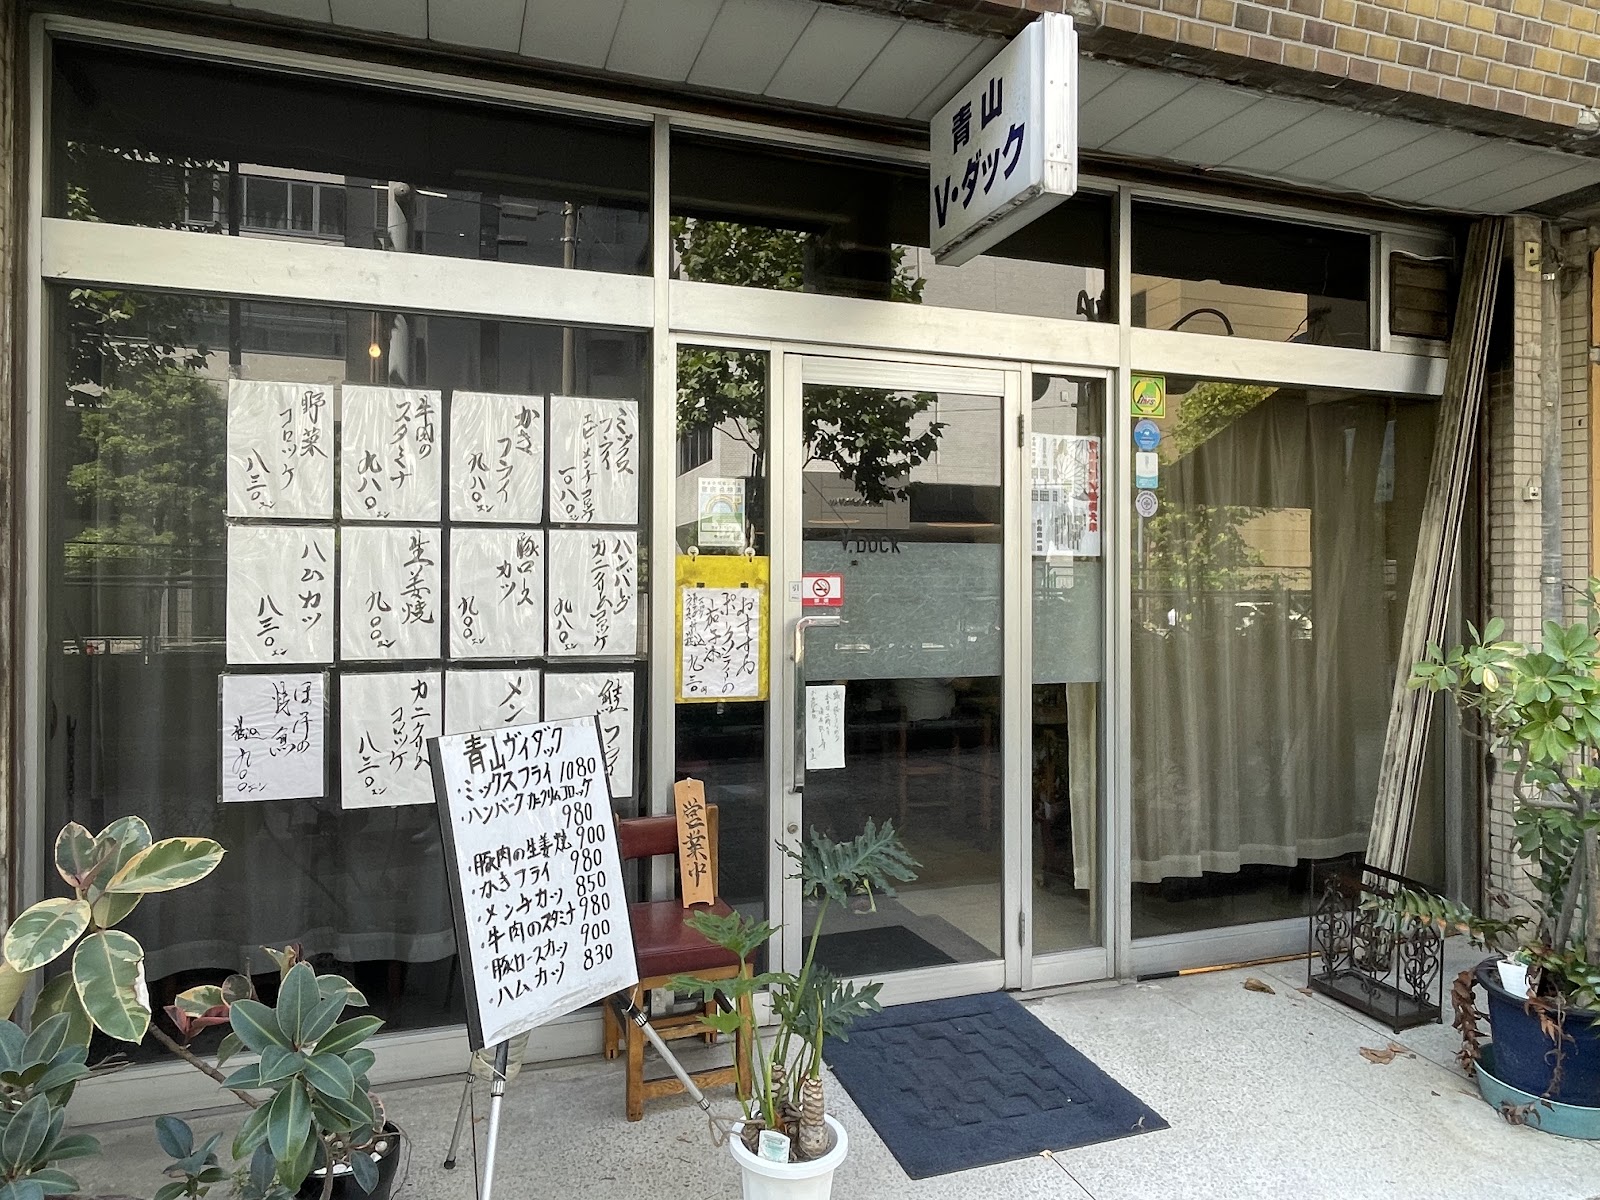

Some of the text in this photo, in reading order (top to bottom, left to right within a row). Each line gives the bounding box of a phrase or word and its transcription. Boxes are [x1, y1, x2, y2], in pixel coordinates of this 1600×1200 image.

[952, 76, 1003, 154] 青山
[279, 408, 297, 490] コロッケ
[300, 390, 328, 459] 野菜
[390, 402, 413, 489] スタミナ
[414, 394, 435, 460] 牛肉の
[514, 405, 540, 456] かき
[599, 419, 615, 470] フライ
[616, 408, 634, 475] ミックス
[496, 437, 514, 503] フライ
[298, 540, 327, 632] ハムカツ
[400, 529, 435, 625] 生姜焼
[496, 560, 516, 606] カツ
[516, 532, 540, 606] 豚ロース
[736, 595, 756, 677] おすすめ
[389, 706, 408, 774] コロッケ
[559, 757, 597, 785] 1080
[562, 802, 593, 829] 980
[576, 824, 606, 850] 900
[682, 797, 708, 888] 営業中
[570, 848, 603, 875] 980
[576, 870, 606, 898] 850
[579, 892, 611, 921] 980
[580, 919, 611, 946] 900
[583, 943, 614, 971] 830
